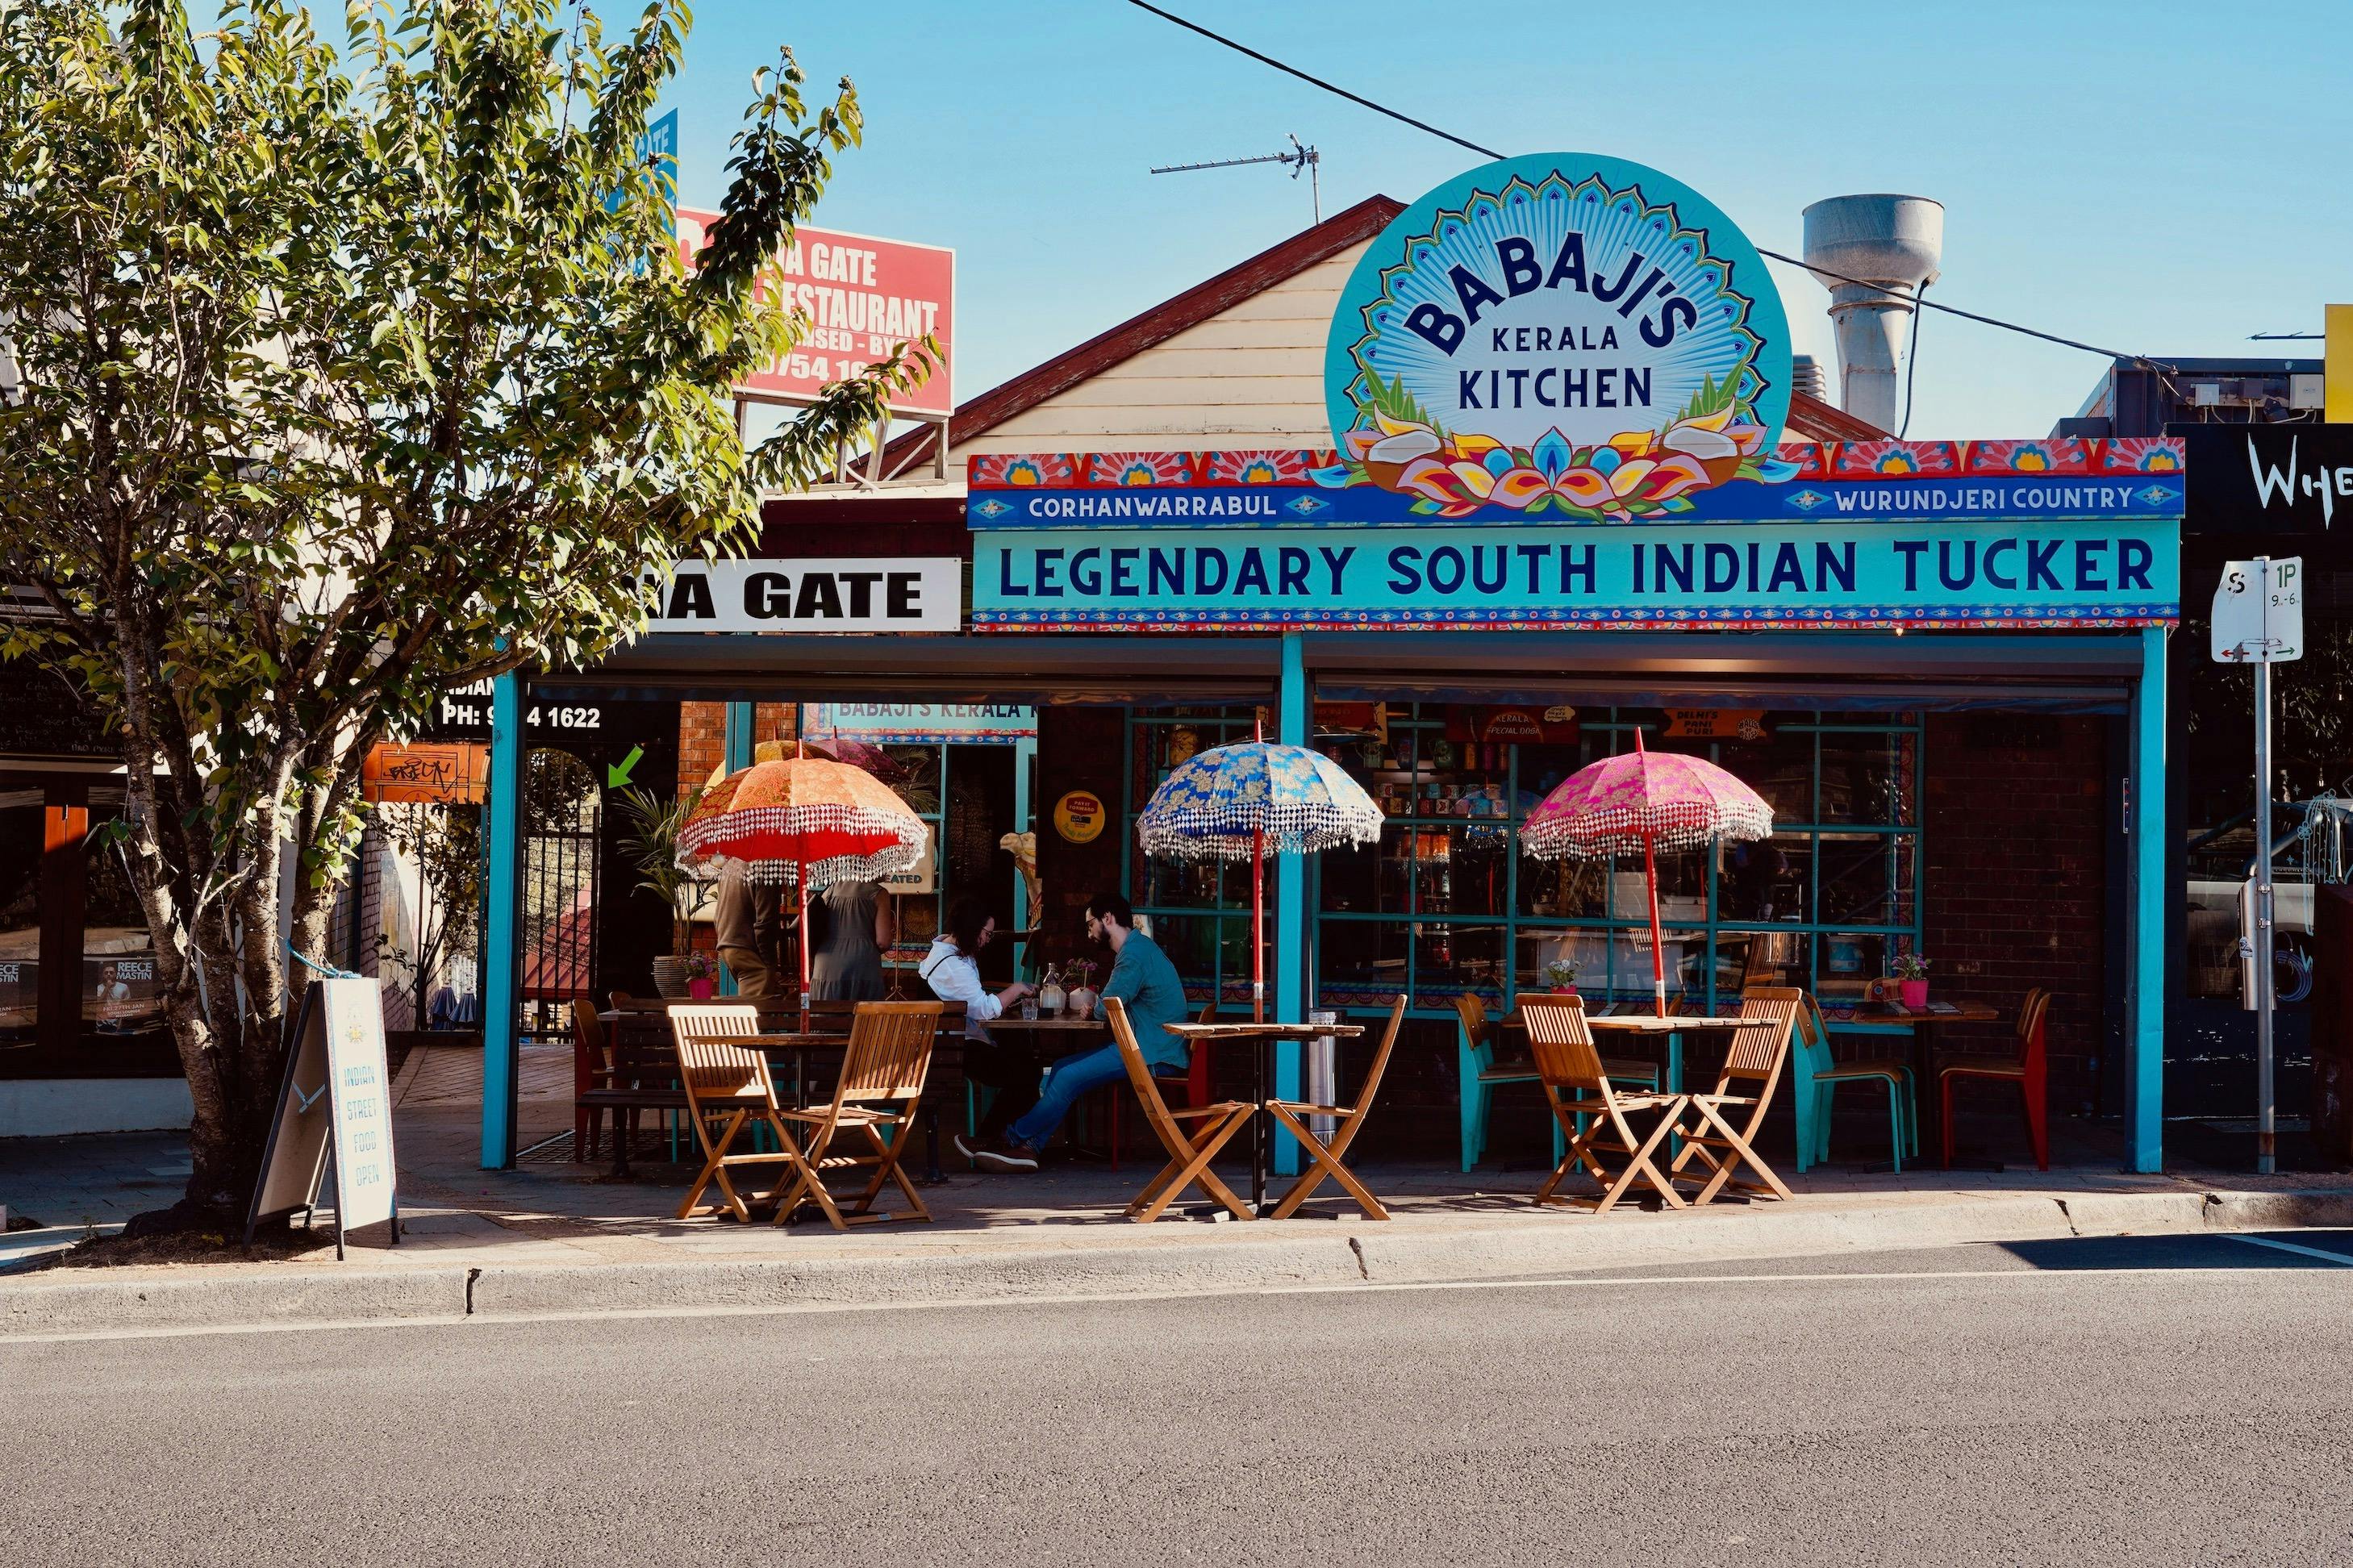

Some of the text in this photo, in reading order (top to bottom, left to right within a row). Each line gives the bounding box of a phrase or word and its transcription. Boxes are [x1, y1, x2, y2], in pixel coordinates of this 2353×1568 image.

[811, 242, 877, 287] GATE
[1403, 231, 1697, 357] BABAJI'S
[1492, 325, 1620, 352] KERALA
[1458, 367, 1652, 410] KITCHEN
[1028, 495, 1278, 518] CORHANWARRABUL
[1834, 486, 2134, 512] WURUNDJERI COUNTRY
[999, 537, 2155, 598] LEGENDARY SOUTH INDIAN TUCKER
[2276, 563, 2297, 589] 1P
[743, 571, 923, 619] GATE
[442, 704, 480, 726] PH:
[548, 707, 600, 728] 1622
[941, 704, 1021, 718] KERALA
[1496, 715, 1529, 723] KERALA
[1677, 711, 1718, 719] DELHI'S
[885, 874, 923, 884] EATED
[116, 971, 152, 980] MASTIN
[117, 961, 152, 973] REECE
[344, 1066, 375, 1087] INDIAN
[347, 1098, 377, 1120] STREET
[353, 1131, 377, 1153] FOOD
[356, 1164, 380, 1187] OPEN
